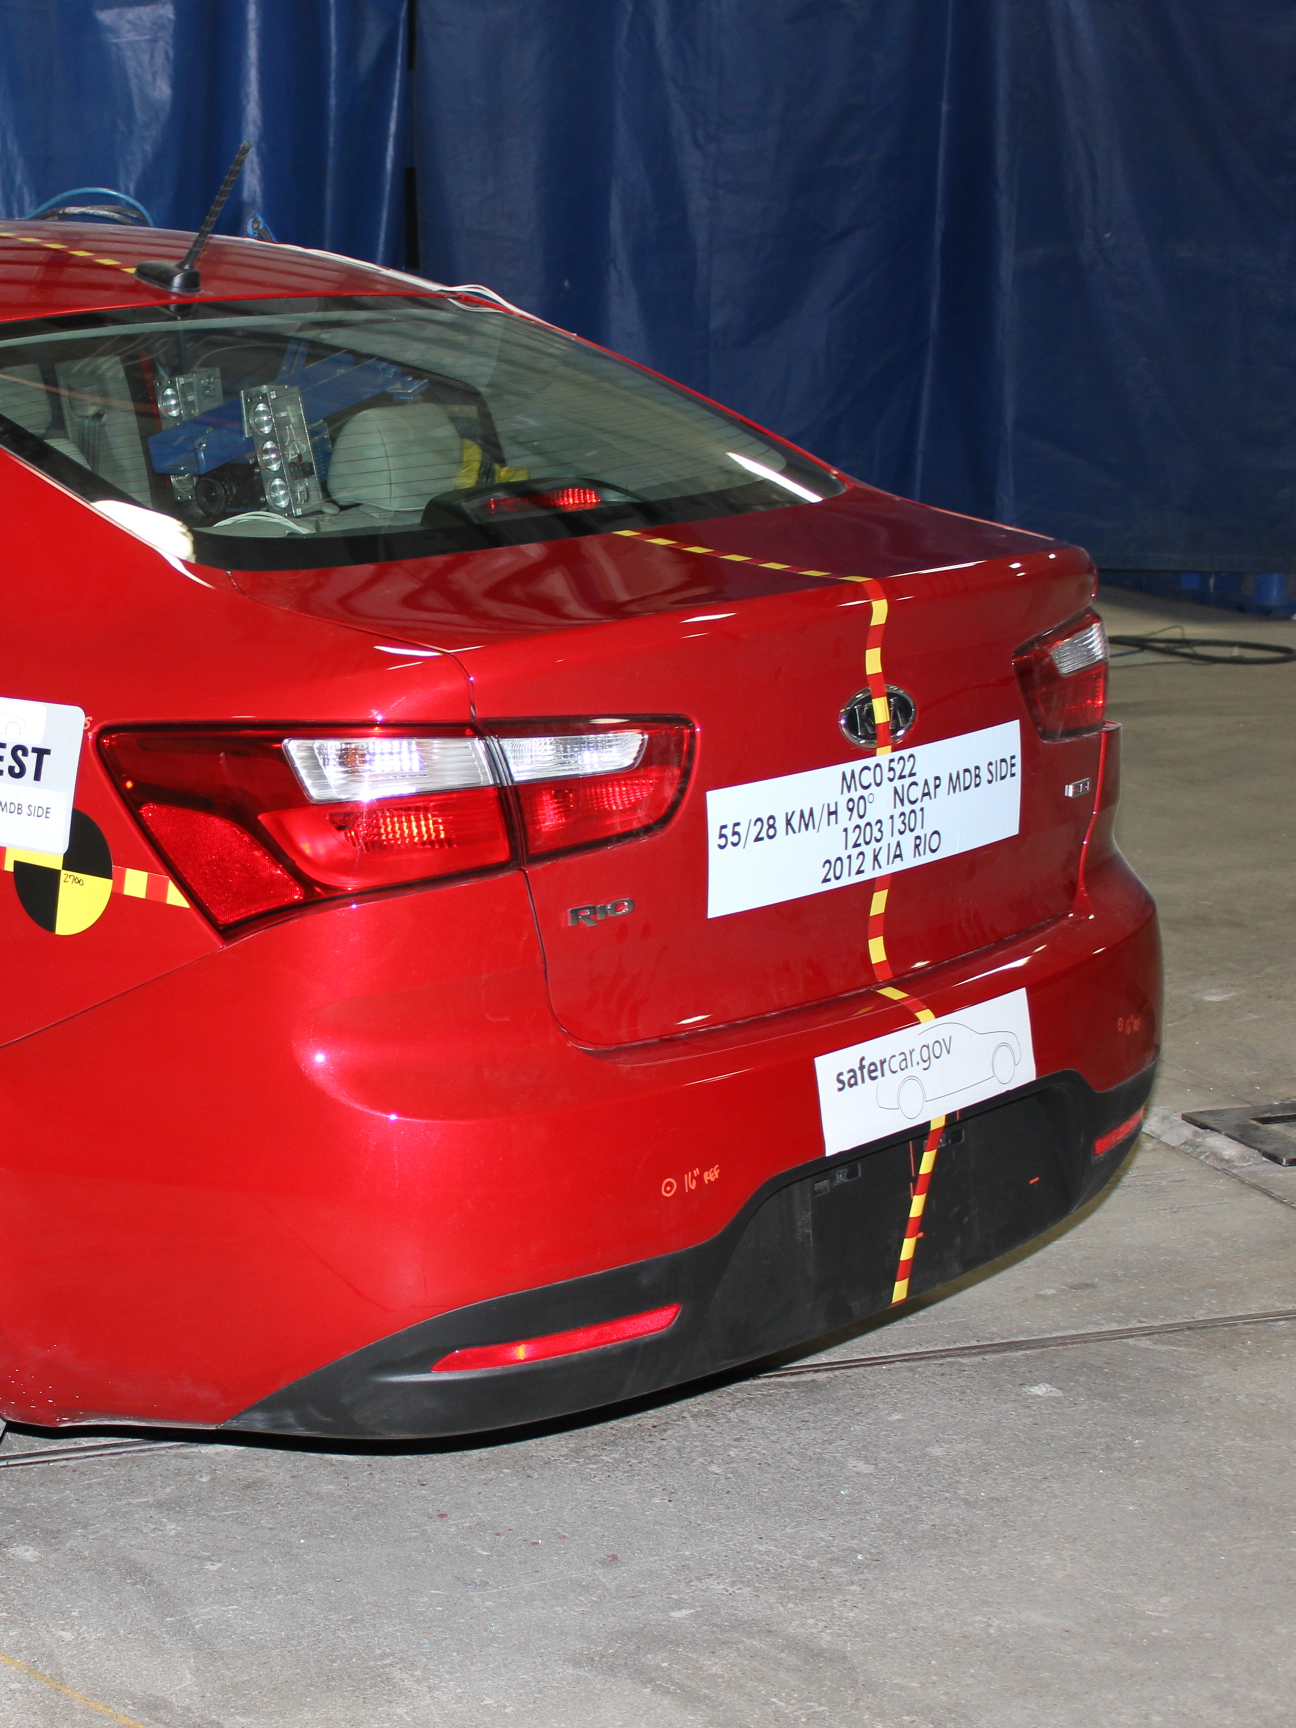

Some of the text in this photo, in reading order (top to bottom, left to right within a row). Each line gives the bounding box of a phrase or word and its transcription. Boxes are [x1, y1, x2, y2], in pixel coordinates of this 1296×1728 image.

[840, 753, 917, 796] MC0522
[26, 804, 52, 819] SIDE
[716, 814, 778, 850] 55/28
[784, 801, 839, 836] KM/H
[892, 775, 942, 810] NCAP
[947, 765, 982, 796] MDB
[986, 754, 1017, 785] SIDE
[842, 806, 925, 851] 12031301
[821, 829, 942, 884] 2012 KIA RIO
[63, 873, 84, 886] 2700
[835, 1035, 952, 1093] safercar.gov
